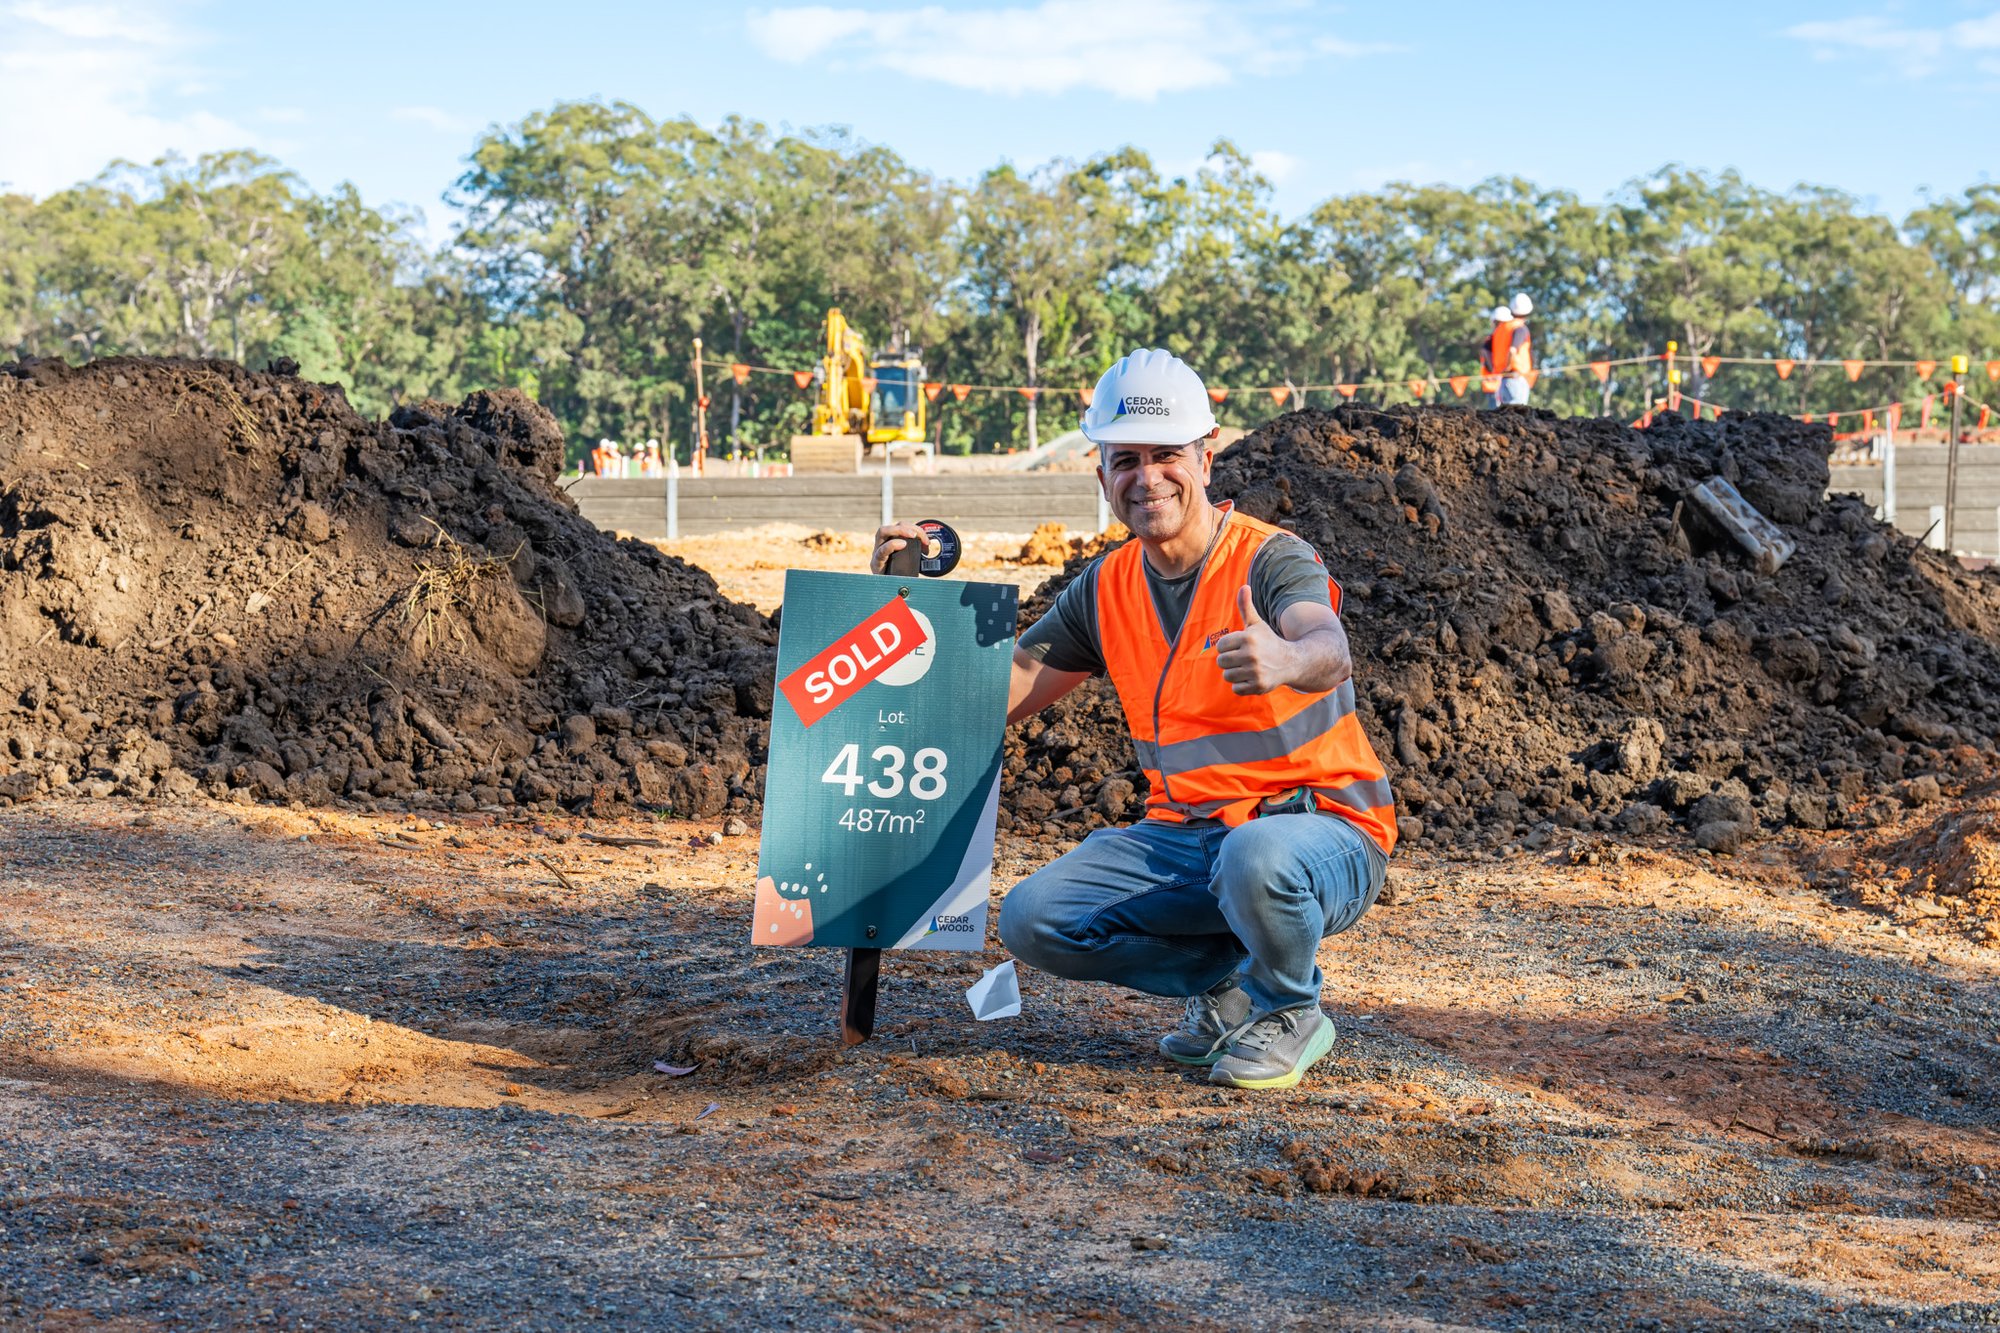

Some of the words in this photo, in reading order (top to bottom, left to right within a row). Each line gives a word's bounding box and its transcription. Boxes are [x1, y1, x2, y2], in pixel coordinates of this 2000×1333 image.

[1125, 397, 1162, 406] CEDAR
[1127, 406, 1170, 416] WOODS
[805, 622, 901, 704] SOLD
[878, 709, 905, 724] Lot
[821, 743, 948, 800] 438
[937, 915, 969, 924] CEDAR
[938, 924, 975, 933] WOODS
